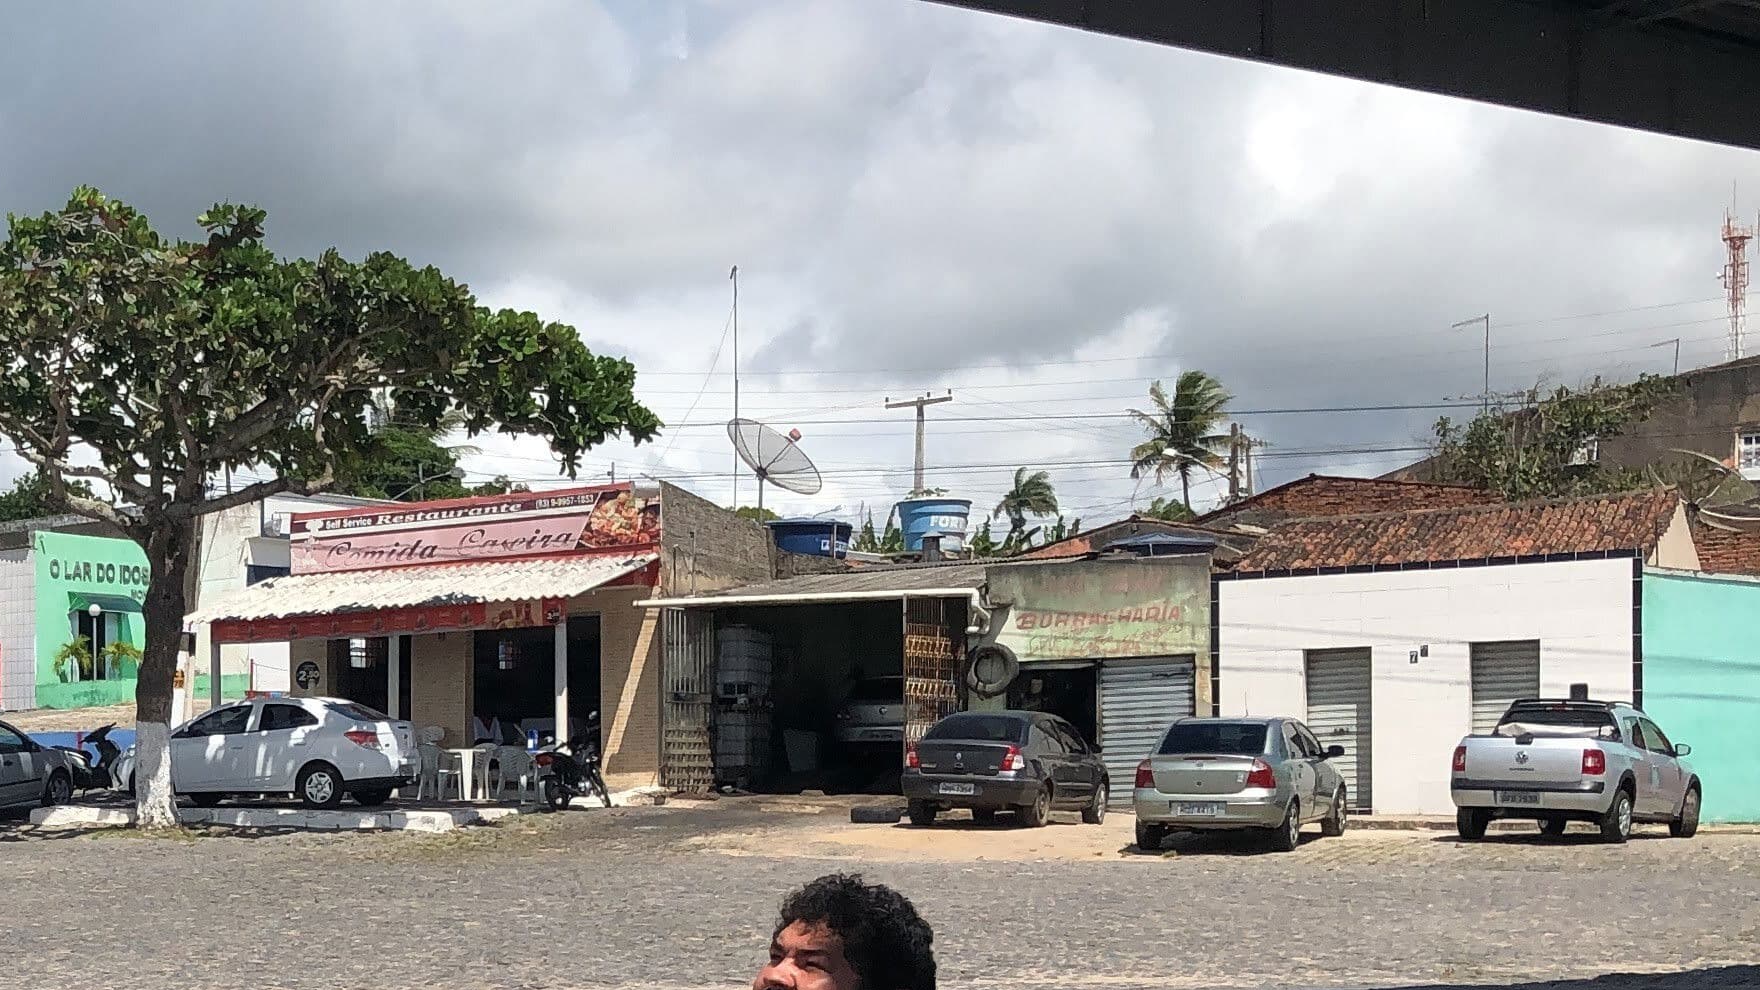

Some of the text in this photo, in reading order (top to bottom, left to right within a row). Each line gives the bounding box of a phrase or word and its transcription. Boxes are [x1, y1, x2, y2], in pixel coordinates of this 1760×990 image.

[376, 503, 522, 525] Restaurante
[325, 529, 575, 568] Comida Caseira
[49, 559, 150, 586] O LAR DO IDOS
